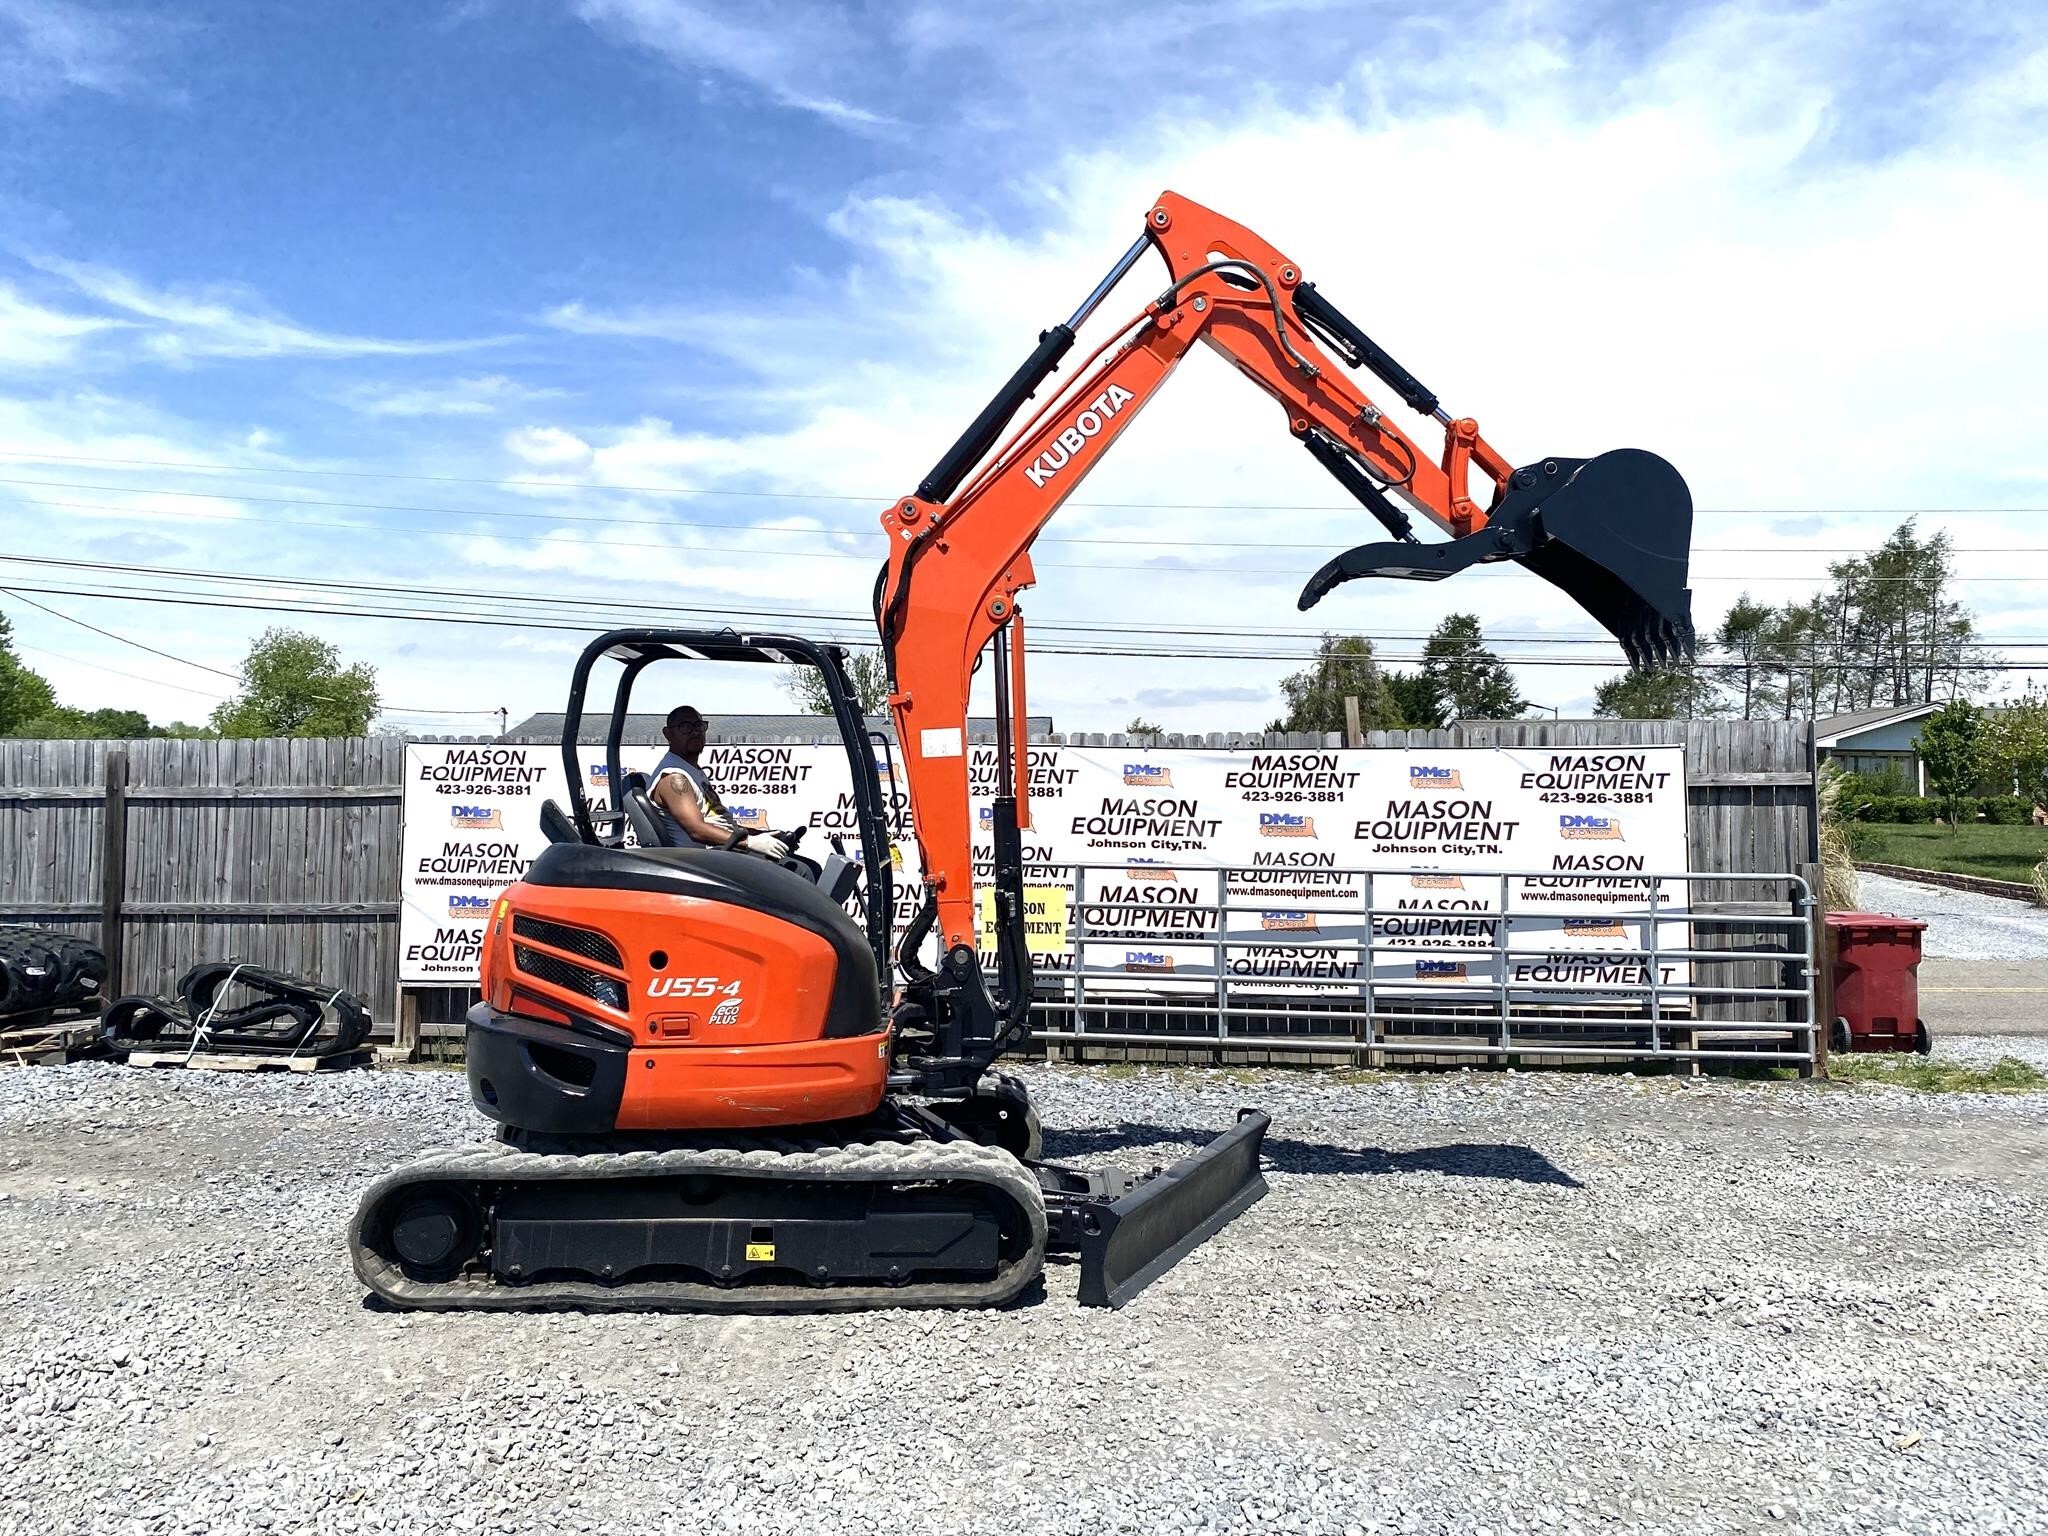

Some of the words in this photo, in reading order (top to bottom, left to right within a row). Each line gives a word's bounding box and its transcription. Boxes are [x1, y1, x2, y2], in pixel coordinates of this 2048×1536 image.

[1024, 383, 1136, 489] KUBOTA
[445, 749, 527, 766] MASON
[709, 748, 792, 765] MASON
[1251, 755, 1339, 771] MASON
[1549, 755, 1646, 772] MASON
[419, 765, 547, 783] EQUIPMENT
[702, 765, 813, 781] QUIPMENT
[1225, 772, 1361, 789] EQUIPMENT
[711, 784, 797, 795] 3-926-3881
[1520, 773, 1671, 790] EQUIPMENT
[435, 784, 532, 796] 423-926-3881
[1241, 791, 1345, 803] 423-926-3881
[1538, 792, 1654, 804] 423-926-3881
[1100, 798, 1198, 818] MASON
[1387, 800, 1492, 819] MASON
[1070, 817, 1223, 838] EQUIPMENT
[1354, 821, 1520, 841] EQUIPMENT
[443, 842, 519, 858] MASON
[1087, 838, 1146, 849] Johnson
[1151, 840, 1207, 851] City,TN.
[1372, 843, 1437, 853] Johnson
[1441, 844, 1503, 856] City,TN.
[972, 845, 1053, 861] MON
[1252, 852, 1336, 867] MASON
[418, 858, 535, 874] EQUIPMENT
[1552, 854, 1645, 871] MASON
[415, 876, 517, 888] www.dmasonequipmen
[1227, 870, 1355, 885] EQUIPMENT
[1524, 876, 1663, 889] EQUIPMEN
[1099, 885, 1199, 904] MASON
[1087, 929, 1206, 940] 4239263881
[1373, 917, 1513, 937] EQUIPMEN
[434, 928, 483, 945] MAS
[1387, 938, 1496, 948] 4239263881
[421, 963, 474, 973] Johnson
[1514, 965, 1676, 985] EQUIPMENT
[717, 1006, 739, 1016] eco
[708, 1015, 738, 1025] PLUS
